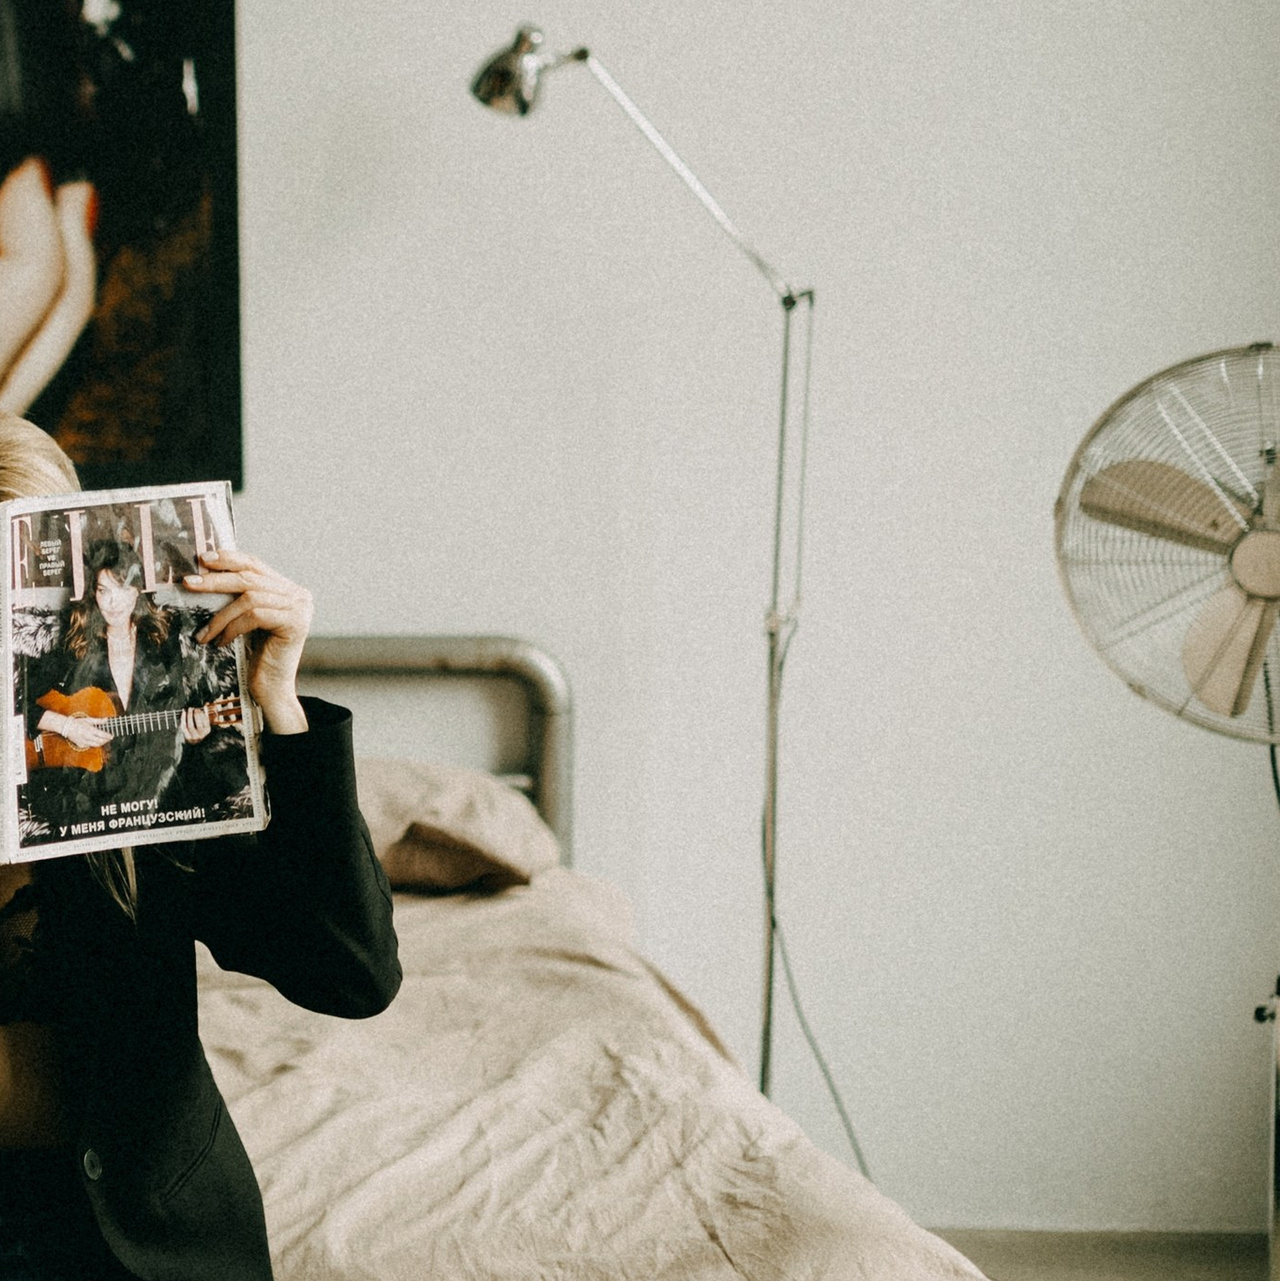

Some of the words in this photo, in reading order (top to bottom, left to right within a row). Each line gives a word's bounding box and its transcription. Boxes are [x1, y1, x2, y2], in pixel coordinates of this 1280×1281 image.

[101, 804, 117, 816] НЕ
[120, 798, 158, 814] МОГУ!
[59, 825, 68, 837] У
[71, 820, 105, 835] МЕНЯ
[108, 806, 206, 830] ФРАНЦУЗСКИЙ!
